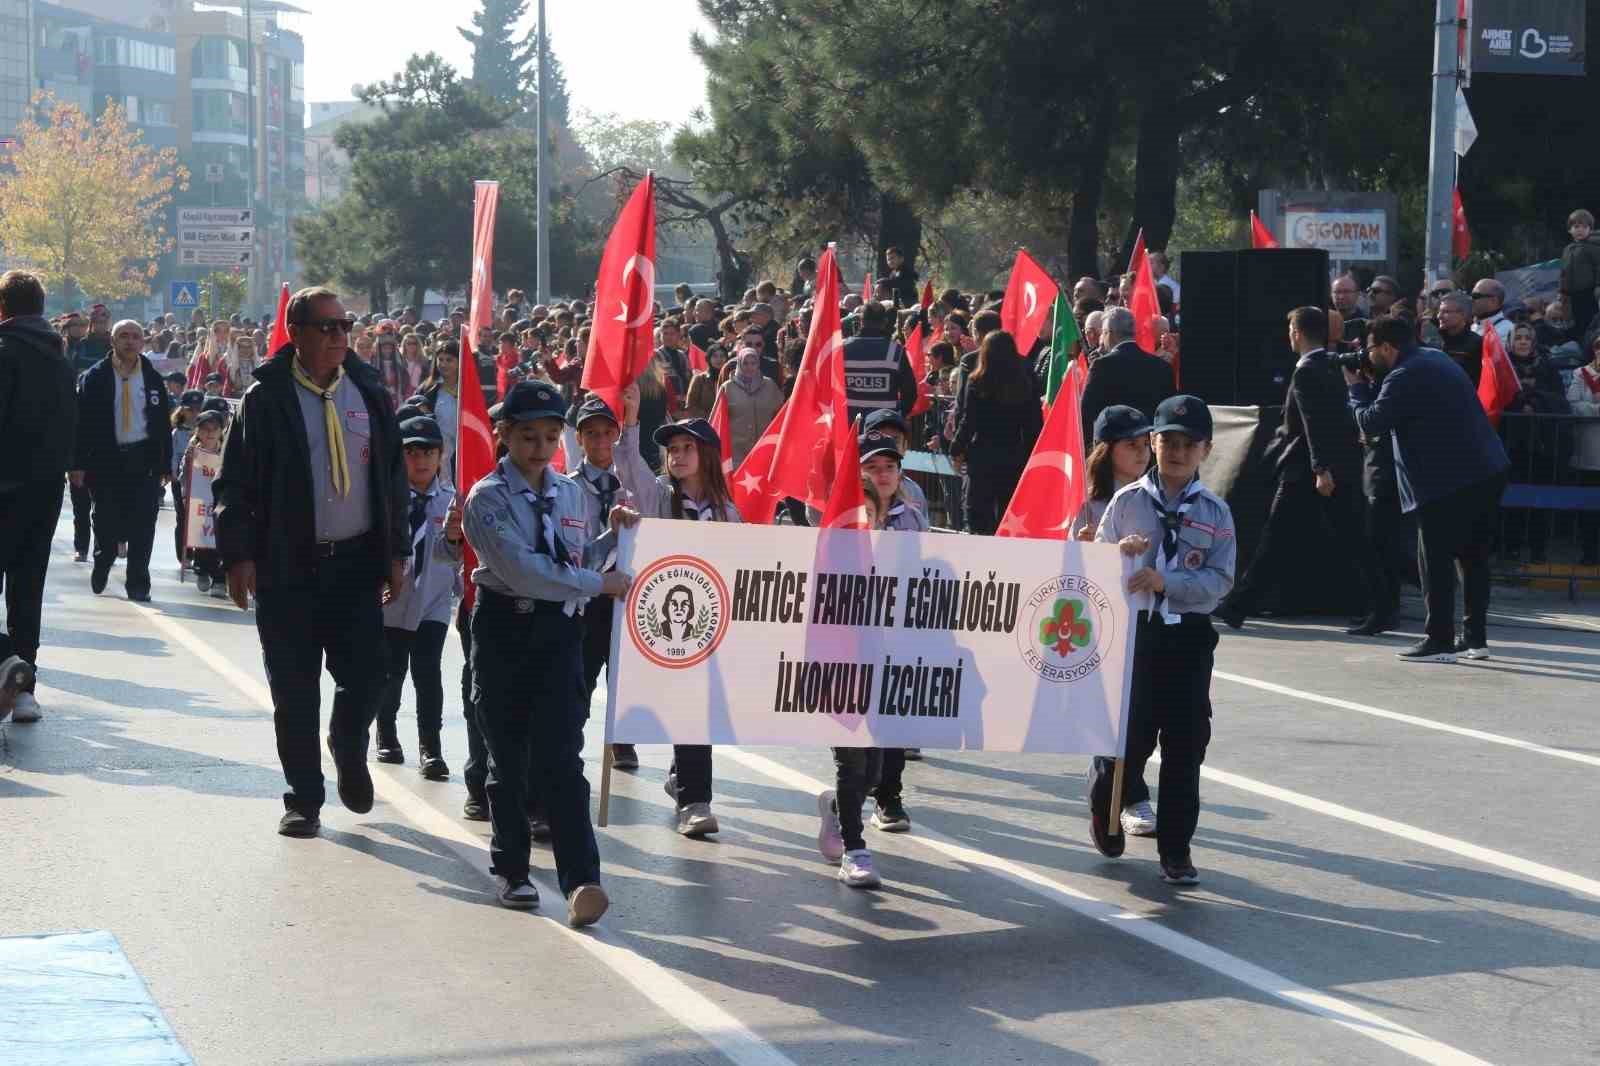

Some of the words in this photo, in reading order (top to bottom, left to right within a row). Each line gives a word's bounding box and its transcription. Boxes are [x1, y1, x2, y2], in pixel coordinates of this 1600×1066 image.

[732, 561, 807, 623] HATİCE
[812, 565, 898, 627] FAHRİYE
[904, 567, 1021, 633] EĞİNLİOĞLU
[1029, 577, 1075, 609] TÜRKİYE
[1077, 577, 1108, 612] İZCİLİK
[775, 651, 874, 715] İLKOKULU
[878, 655, 963, 718] İZCİLERİ
[1024, 648, 1102, 680] FEDERASYONU
